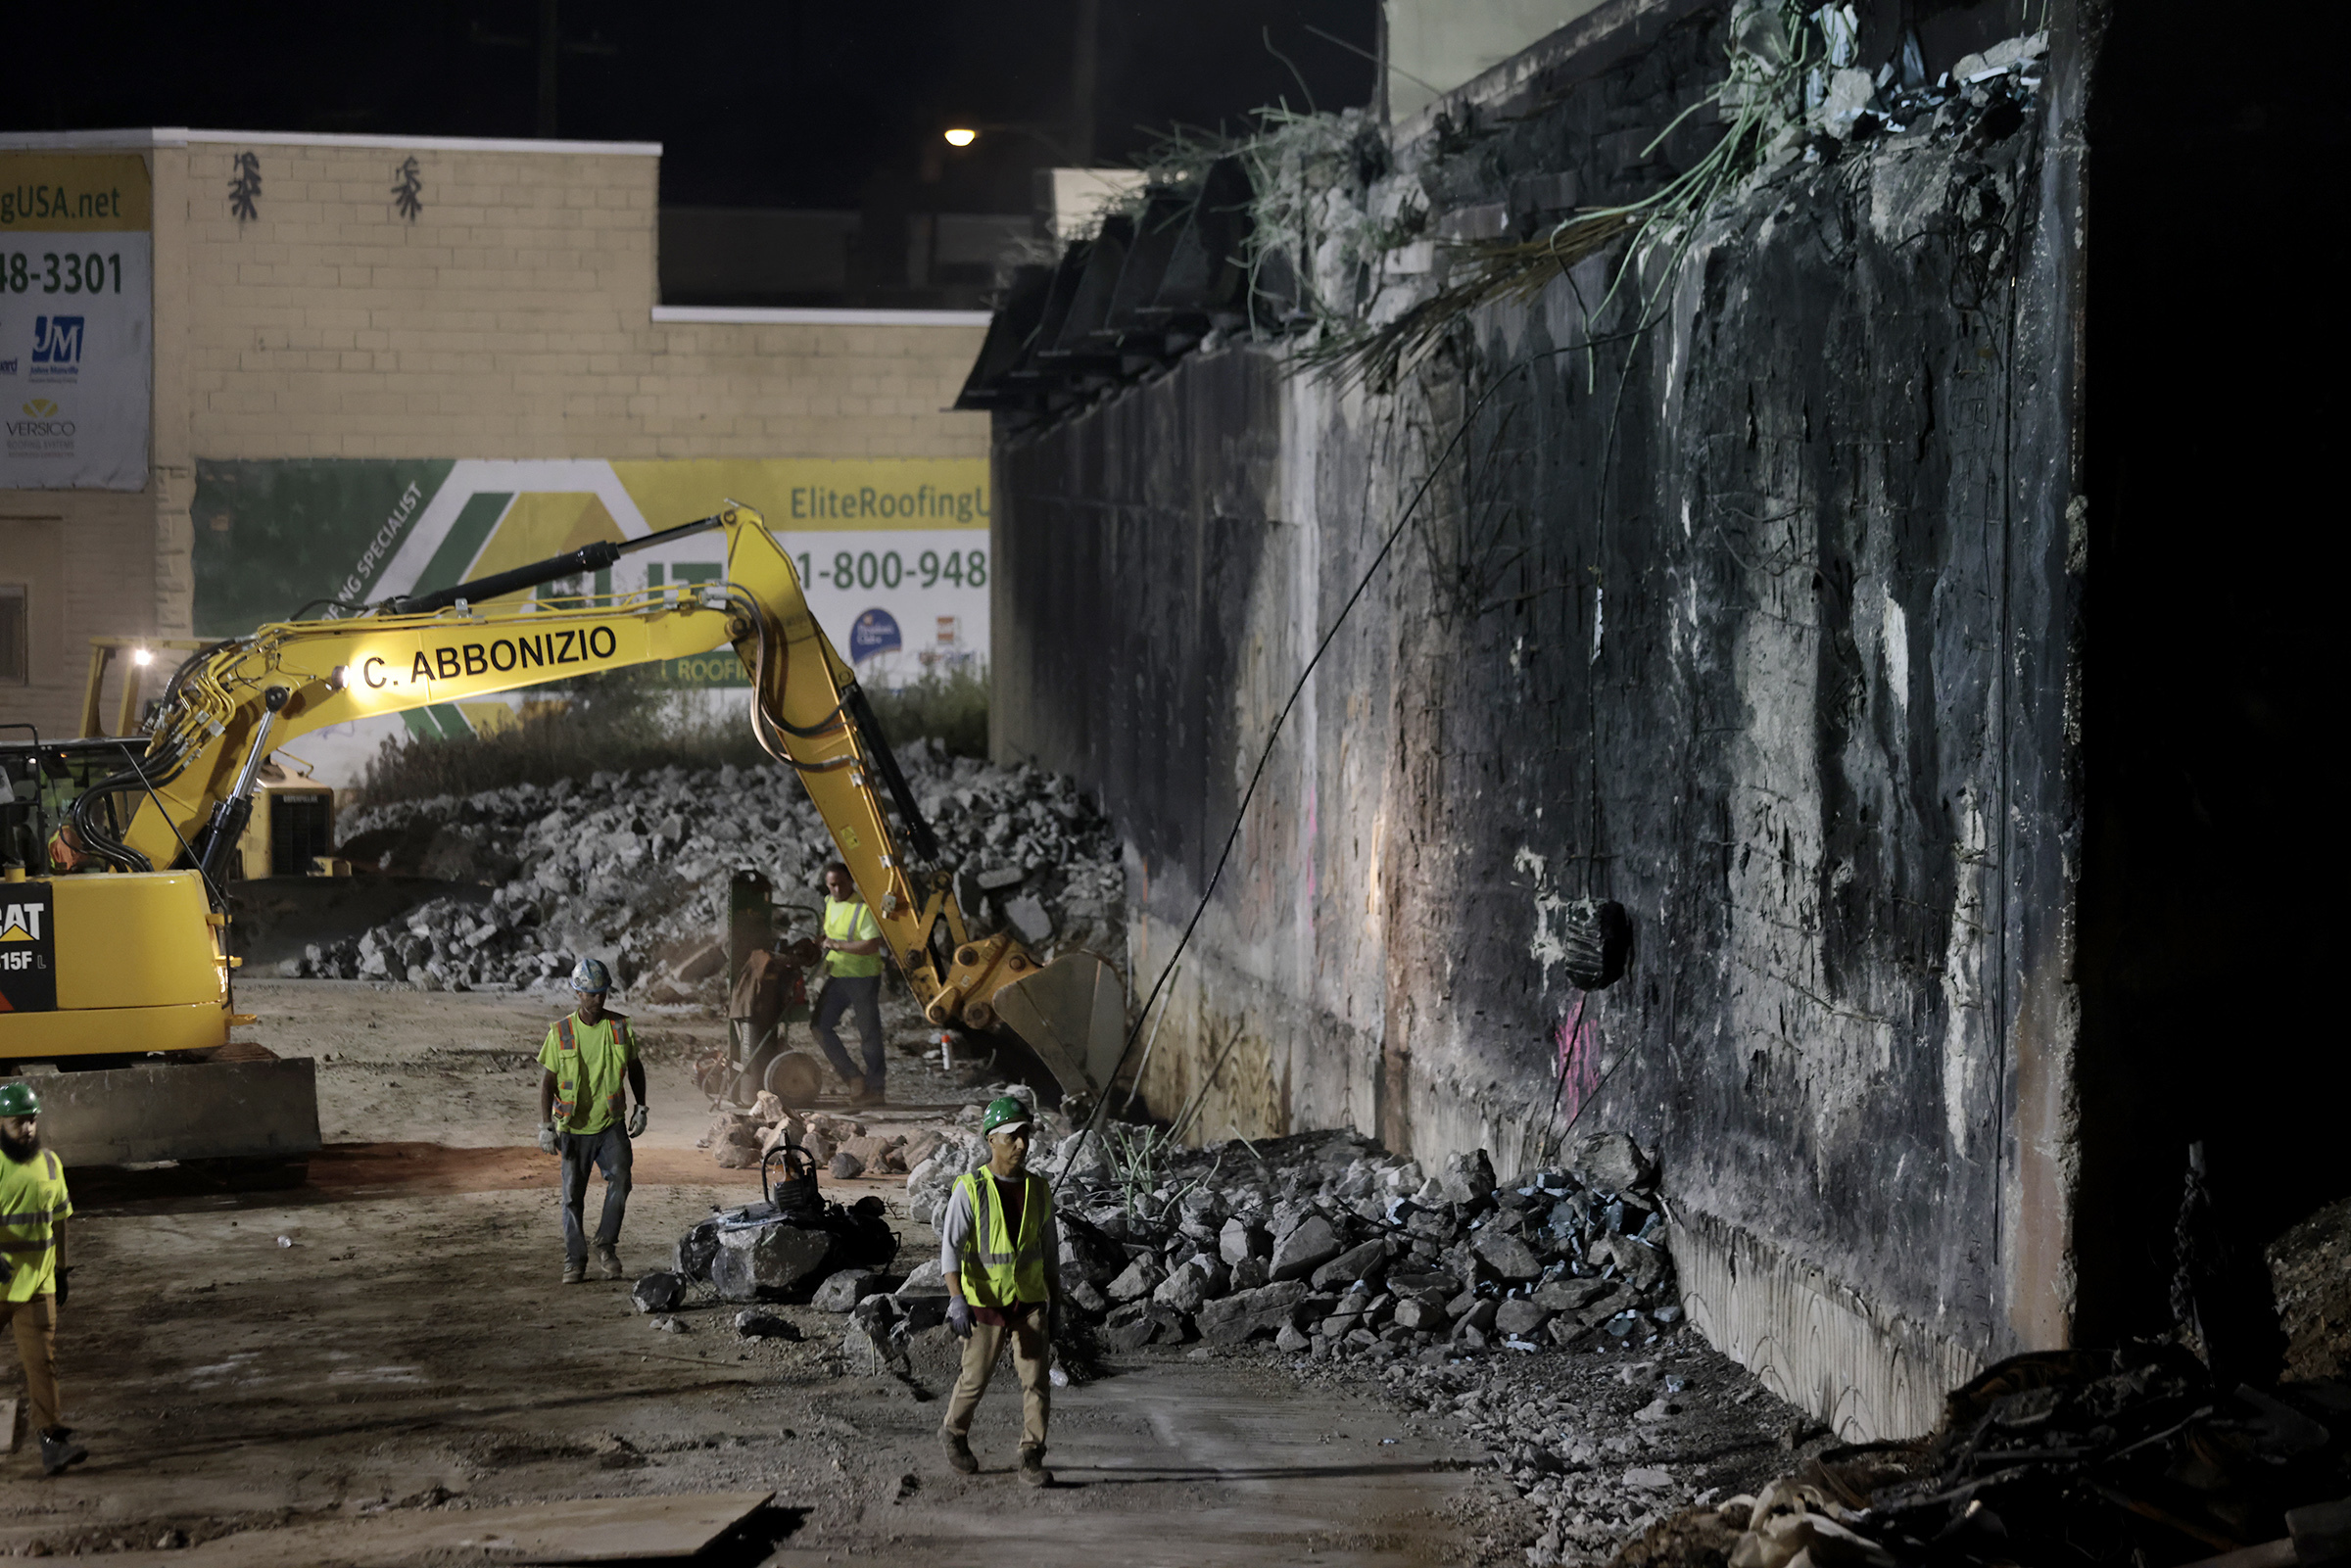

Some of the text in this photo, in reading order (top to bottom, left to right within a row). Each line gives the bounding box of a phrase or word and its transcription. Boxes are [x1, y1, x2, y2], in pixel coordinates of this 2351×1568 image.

[6, 421, 75, 437] VERSICO
[357, 480, 422, 579] SPECIALIST
[363, 657, 398, 689] C.
[410, 626, 616, 684] ABBONIZIO
[0, 903, 44, 941] AT
[0, 951, 32, 970] 15F
